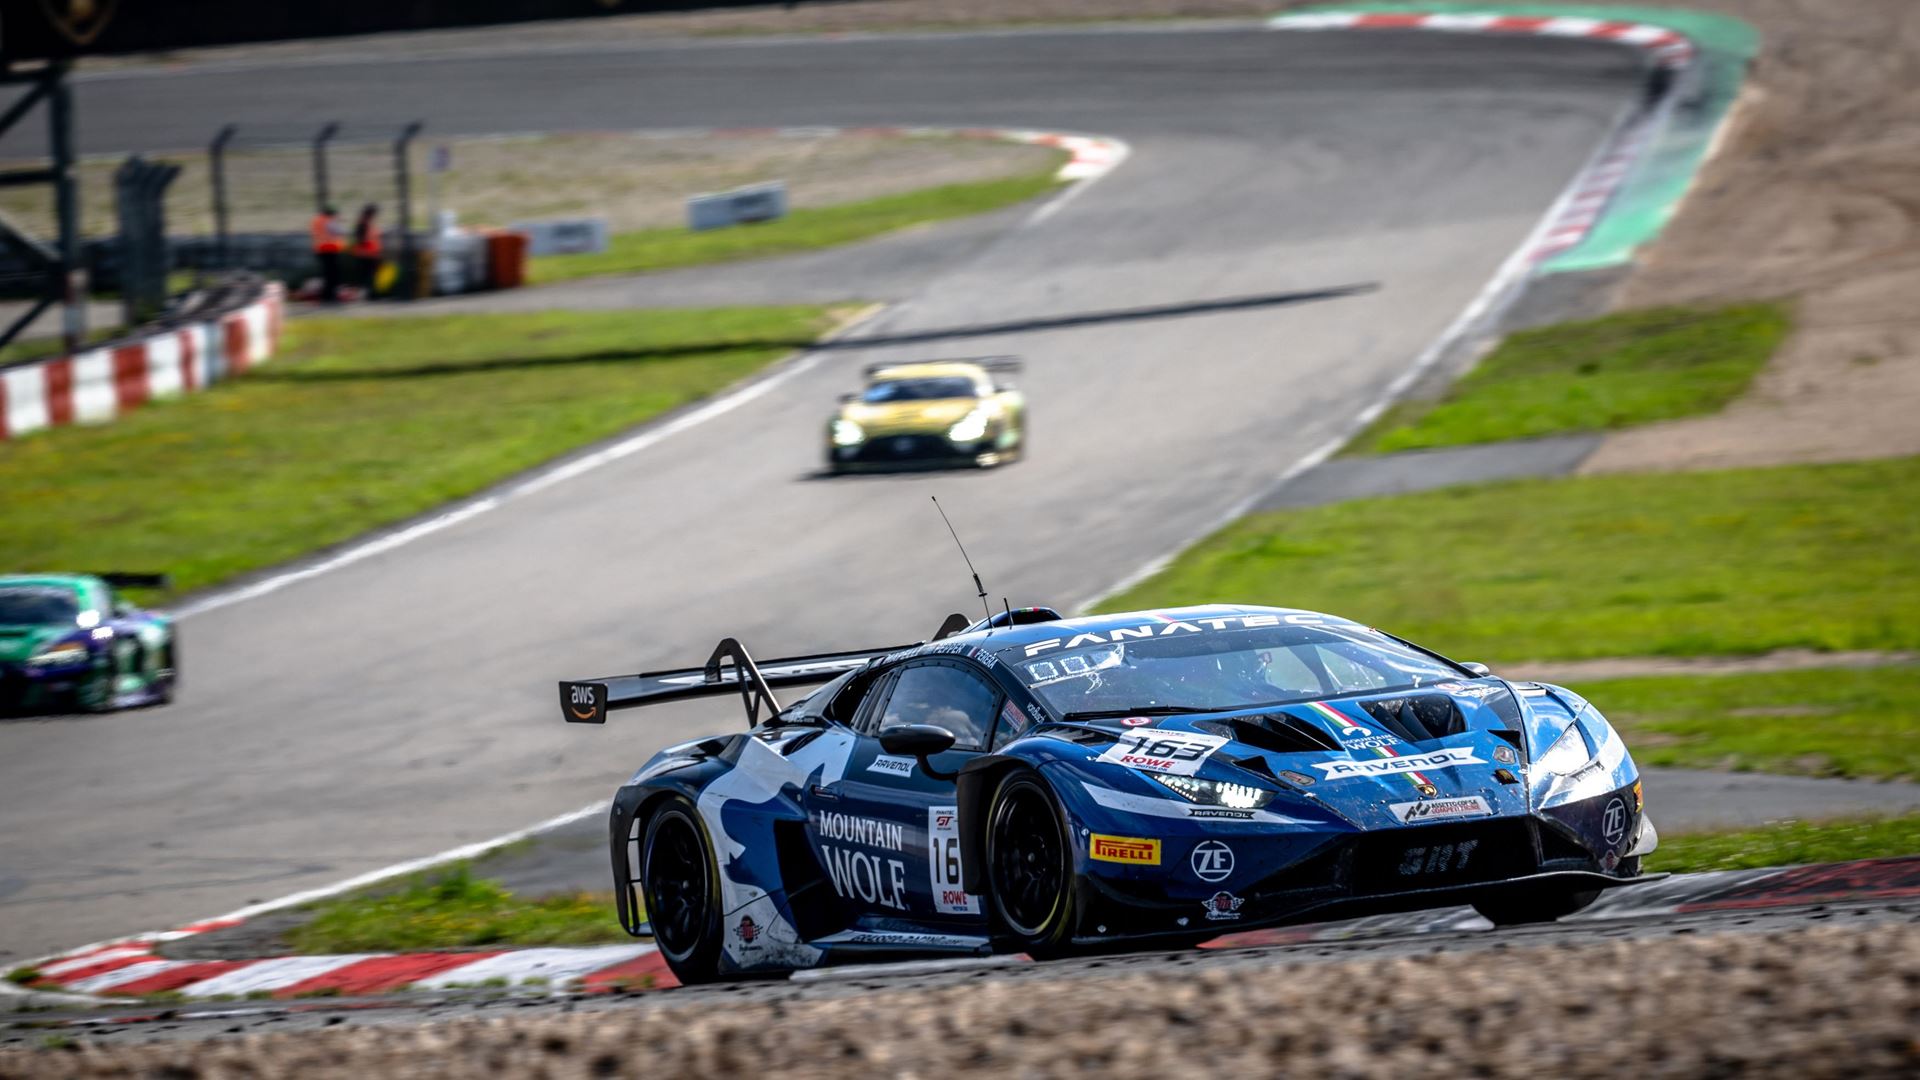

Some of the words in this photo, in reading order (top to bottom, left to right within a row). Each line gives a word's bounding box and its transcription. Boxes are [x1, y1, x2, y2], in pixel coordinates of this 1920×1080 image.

[1024, 614, 1325, 657] FANATEC
[975, 648, 998, 670] PERERA
[571, 685, 596, 705] aws
[1128, 736, 1215, 761] 163
[1349, 739, 1399, 750] WOLF
[874, 759, 912, 773] RAVENOL
[1120, 755, 1175, 769] ROWE
[1194, 810, 1250, 818] RAVENOL
[1605, 804, 1624, 838] ZF
[820, 810, 903, 851] MOUNTAIN
[1096, 839, 1154, 860] PIRELLI
[1195, 849, 1231, 873] ZF
[821, 845, 906, 911] WOLF
[943, 891, 968, 905] ROWE
